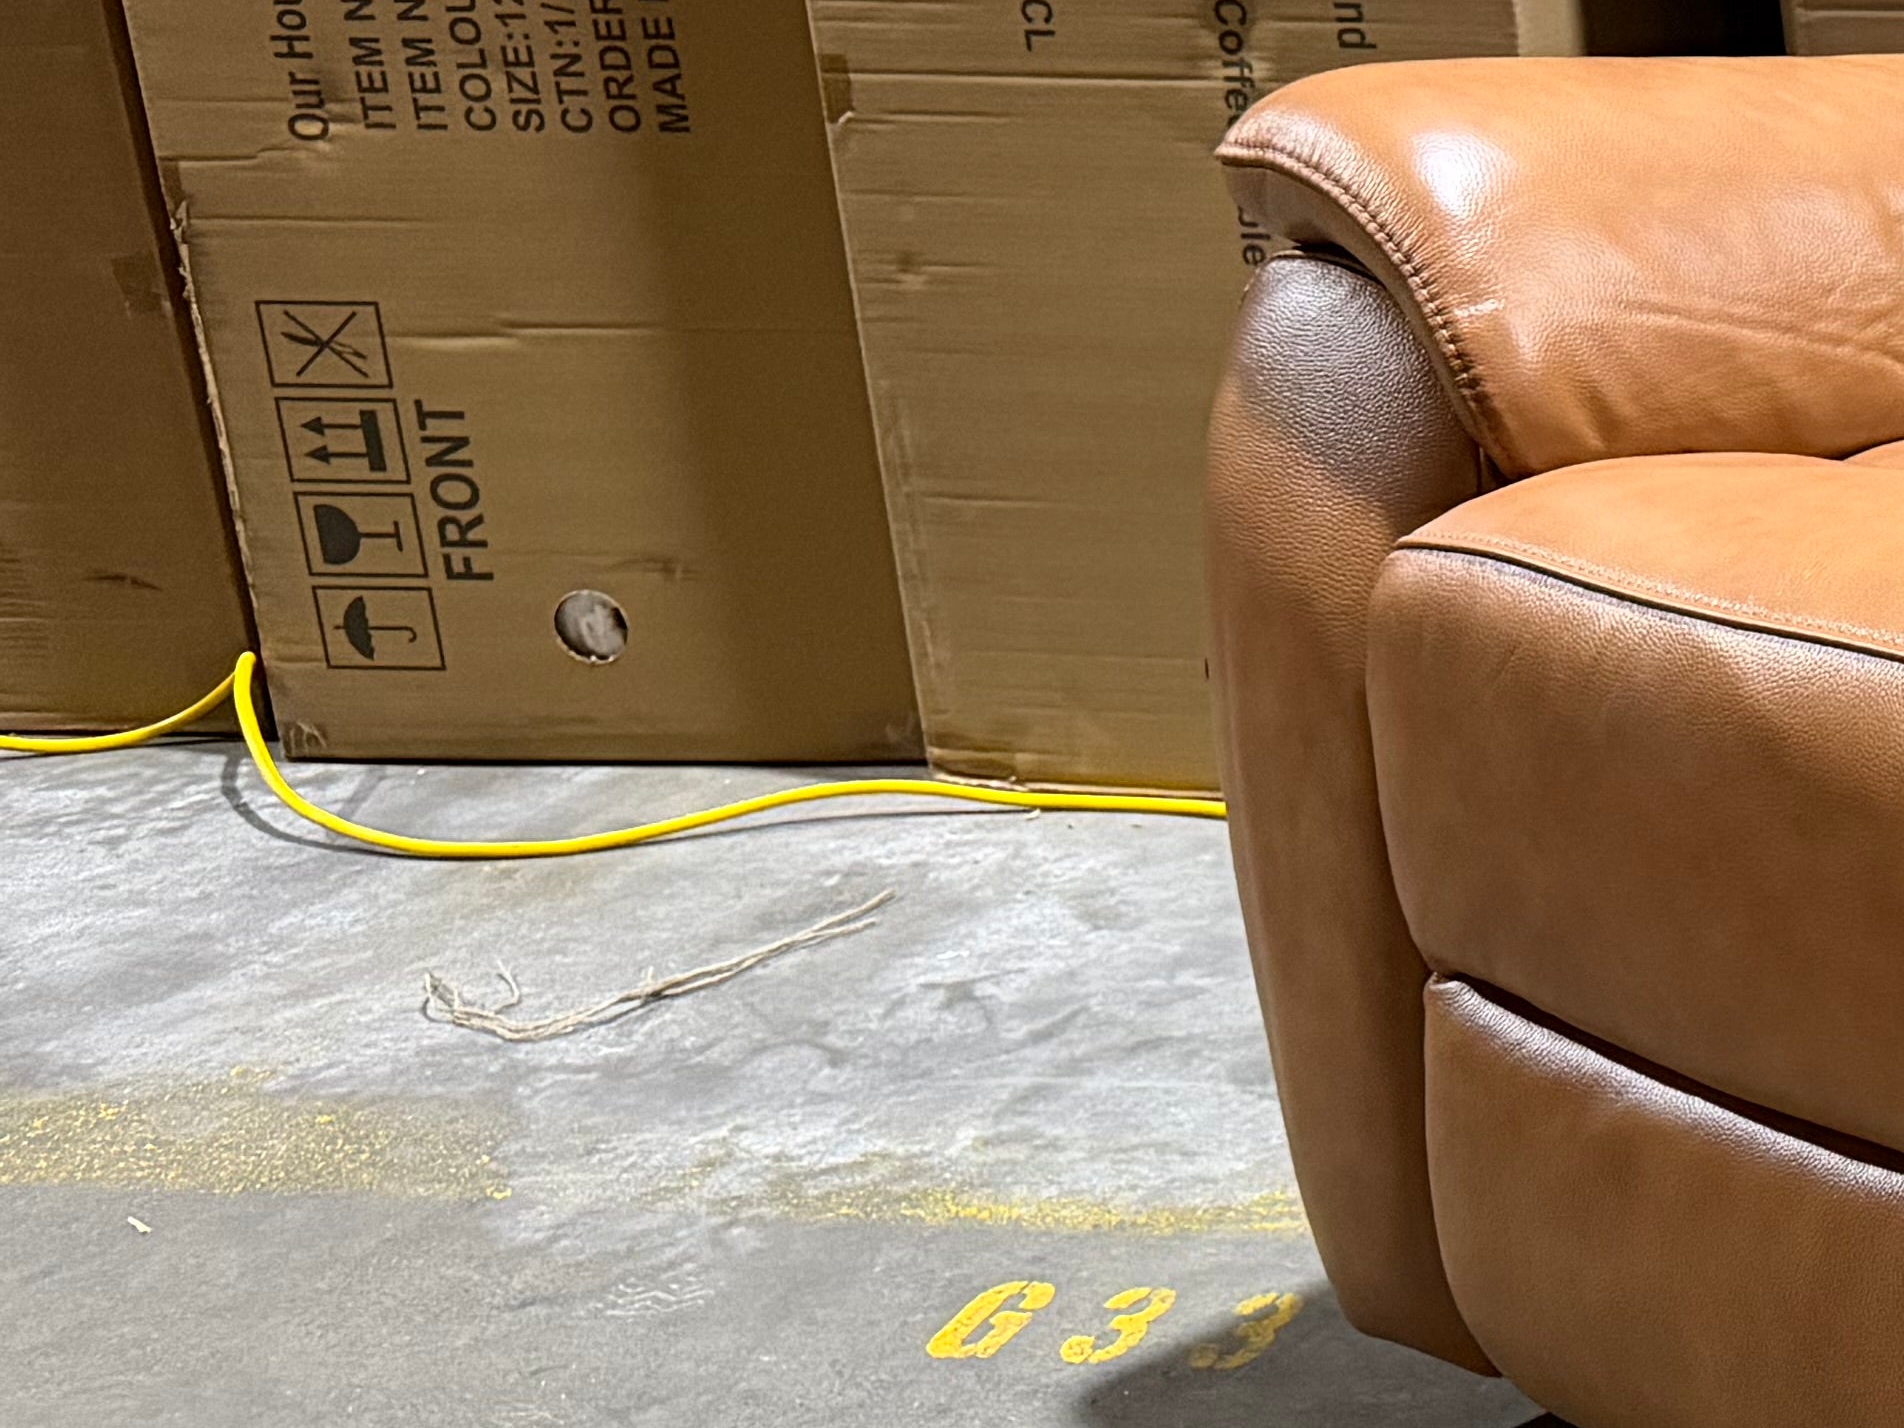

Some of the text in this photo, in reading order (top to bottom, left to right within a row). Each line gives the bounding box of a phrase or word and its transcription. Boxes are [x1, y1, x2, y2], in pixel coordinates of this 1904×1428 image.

[286, 71, 329, 142] Our
[347, 37, 394, 130] ITEM
[404, 38, 449, 131] ITEM
[639, 15, 691, 134] MADE
[414, 398, 494, 582] FRONT
